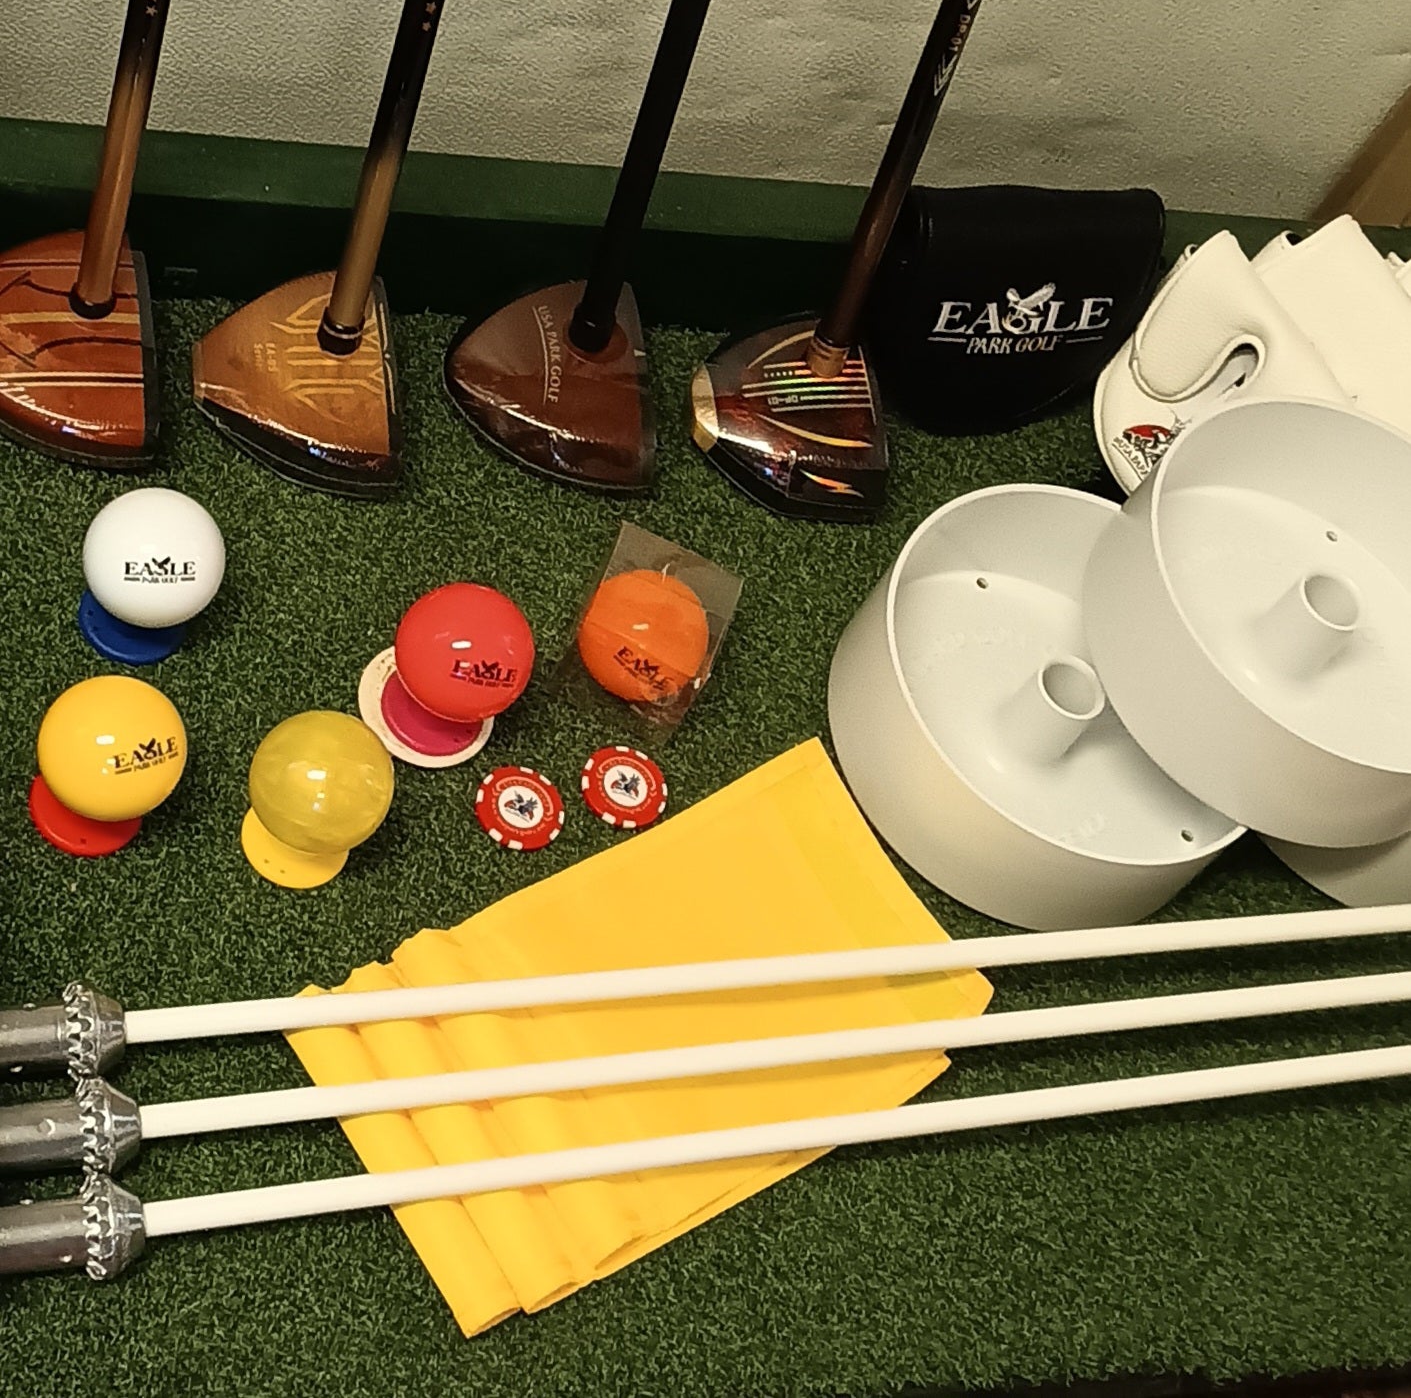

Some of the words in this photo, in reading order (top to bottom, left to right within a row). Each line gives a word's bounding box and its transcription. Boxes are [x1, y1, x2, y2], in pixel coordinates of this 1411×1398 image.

[538, 305, 554, 329] USA
[933, 293, 1114, 336] EAGLE
[547, 331, 562, 362] PARK
[966, 337, 1014, 354] PARK
[1015, 334, 1064, 352] GOLF
[547, 365, 562, 403] GOLF
